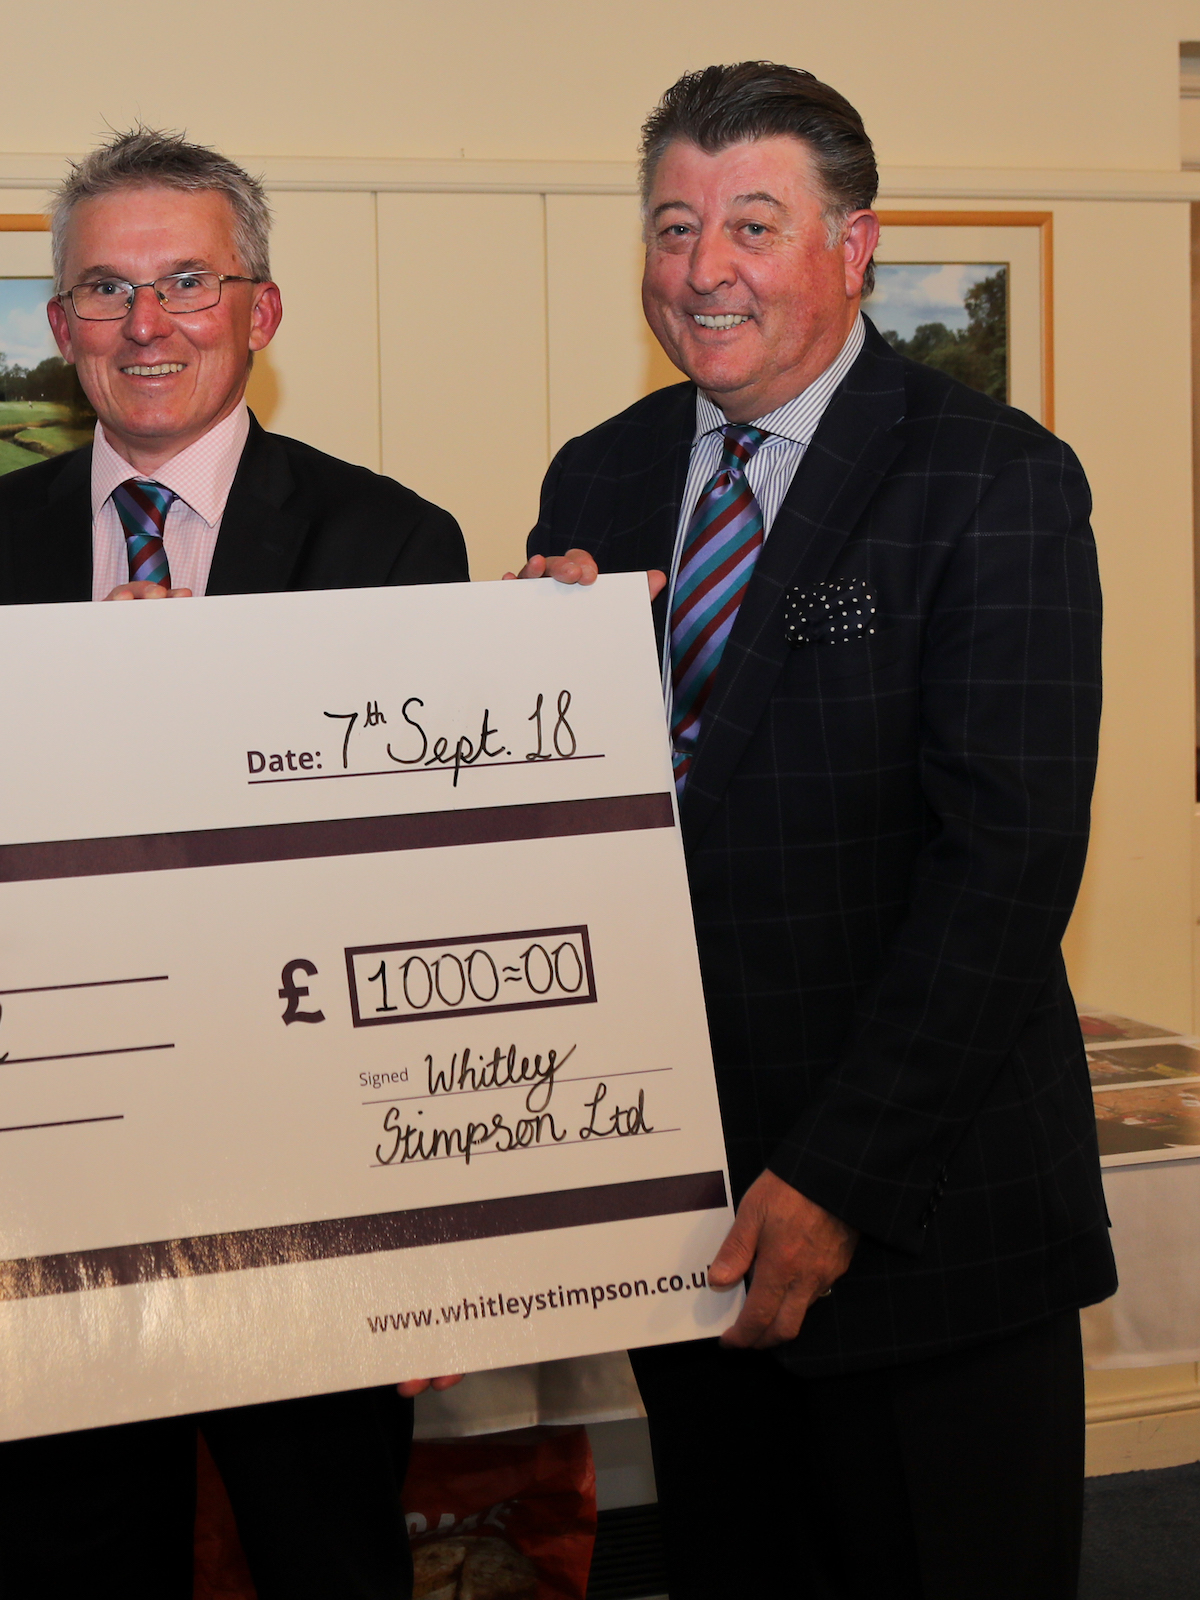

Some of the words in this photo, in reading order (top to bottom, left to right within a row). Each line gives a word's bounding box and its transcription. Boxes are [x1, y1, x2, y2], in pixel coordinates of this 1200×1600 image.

[246, 749, 323, 774] Date:
[386, 696, 512, 788] Sept.
[525, 689, 577, 762] 18
[277, 957, 327, 1026] £
[359, 1067, 410, 1090] Signed
[424, 1043, 577, 1114] Whitley
[375, 1106, 568, 1166] Stimpson
[578, 1082, 655, 1141] Ltd
[367, 1264, 714, 1334] www.whitleystimpson.co.u
